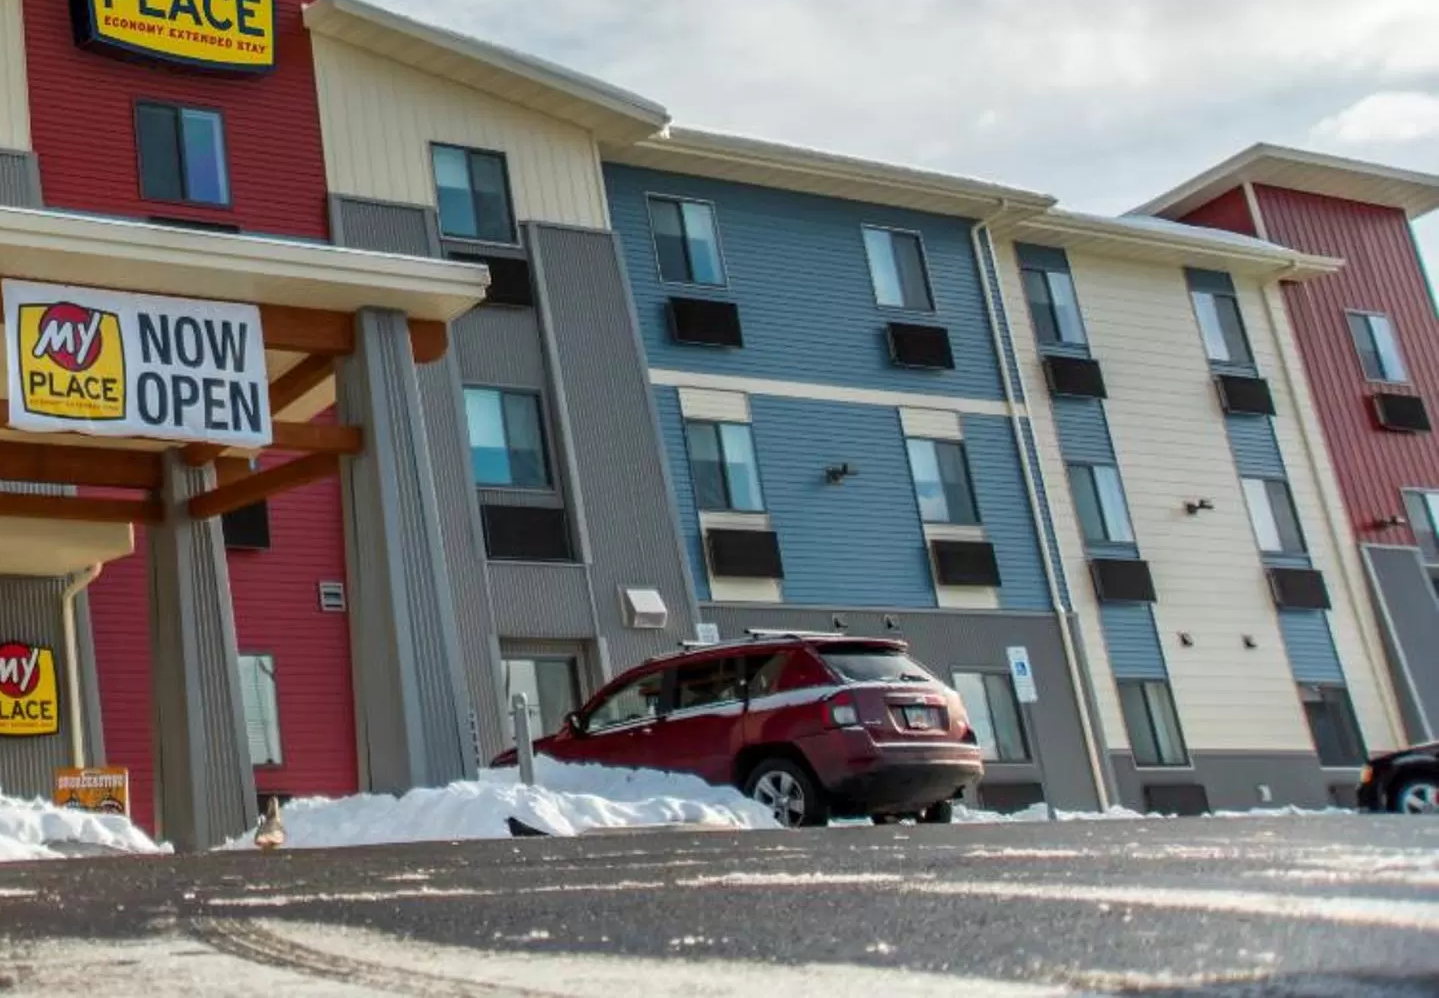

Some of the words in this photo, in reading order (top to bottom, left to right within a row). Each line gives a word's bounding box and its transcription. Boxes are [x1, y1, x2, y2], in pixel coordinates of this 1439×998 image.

[104, 15, 164, 36] ECONOMY
[169, 28, 233, 48] EXTENDED
[236, 40, 267, 54] STAY
[136, 312, 249, 373] NOW
[29, 370, 119, 402] PLACE
[136, 371, 263, 434] OPEN
